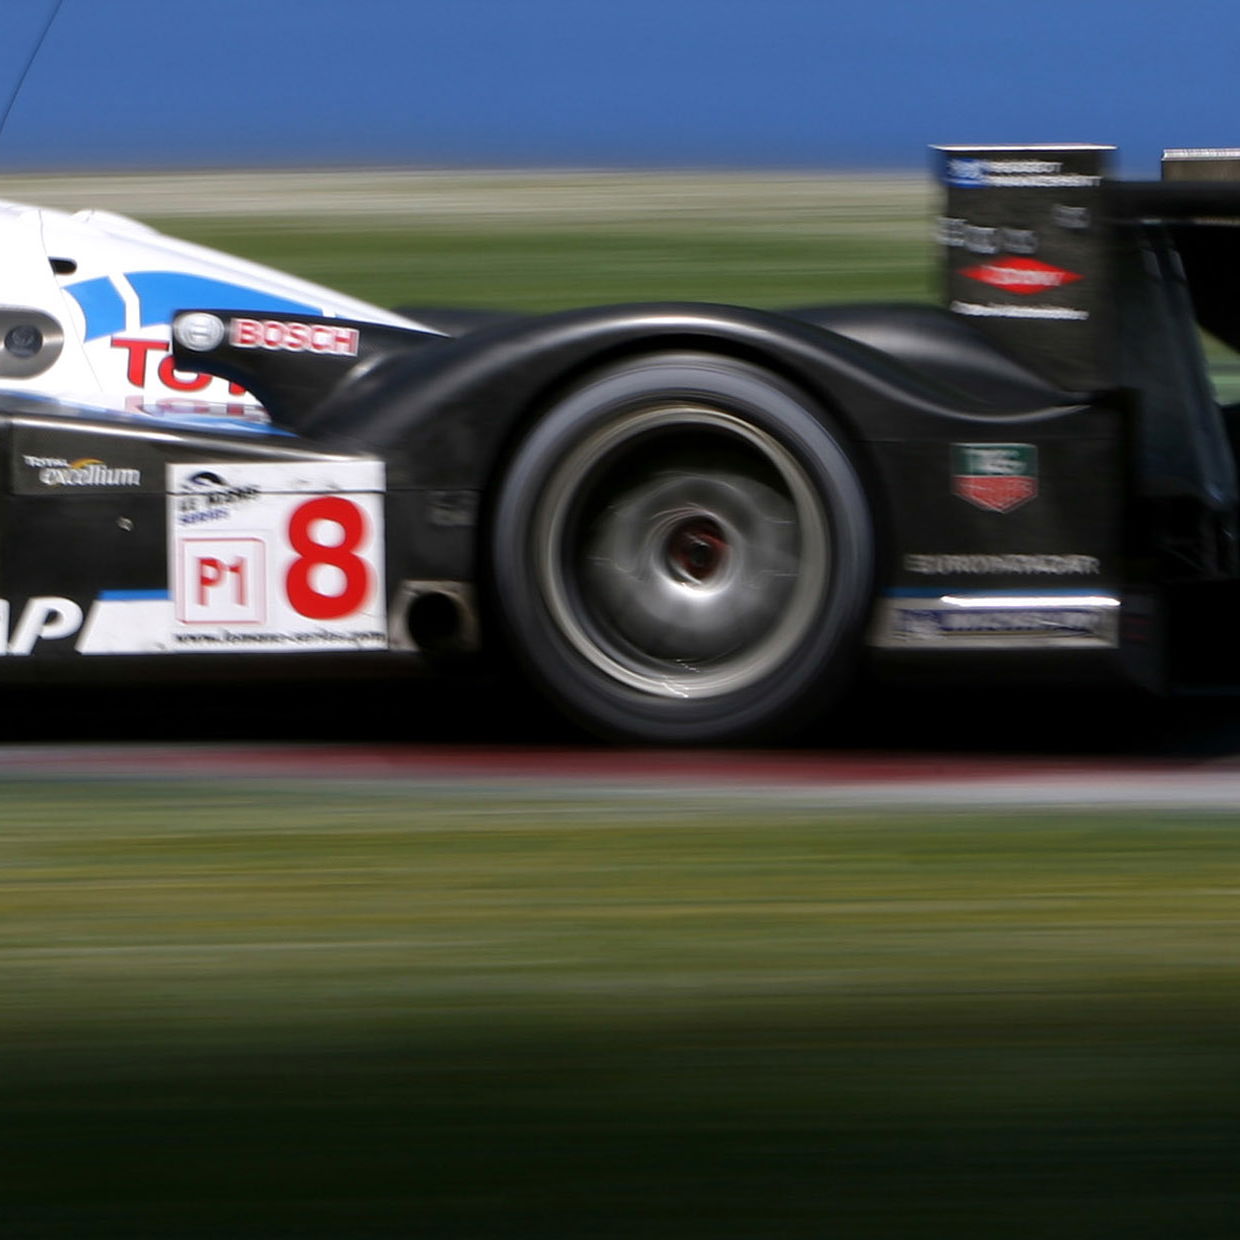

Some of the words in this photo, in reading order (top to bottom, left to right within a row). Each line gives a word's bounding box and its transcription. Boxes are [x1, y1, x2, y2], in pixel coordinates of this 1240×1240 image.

[230, 318, 359, 357] BOSCH
[196, 556, 248, 606] P1
[285, 495, 373, 621] 8
